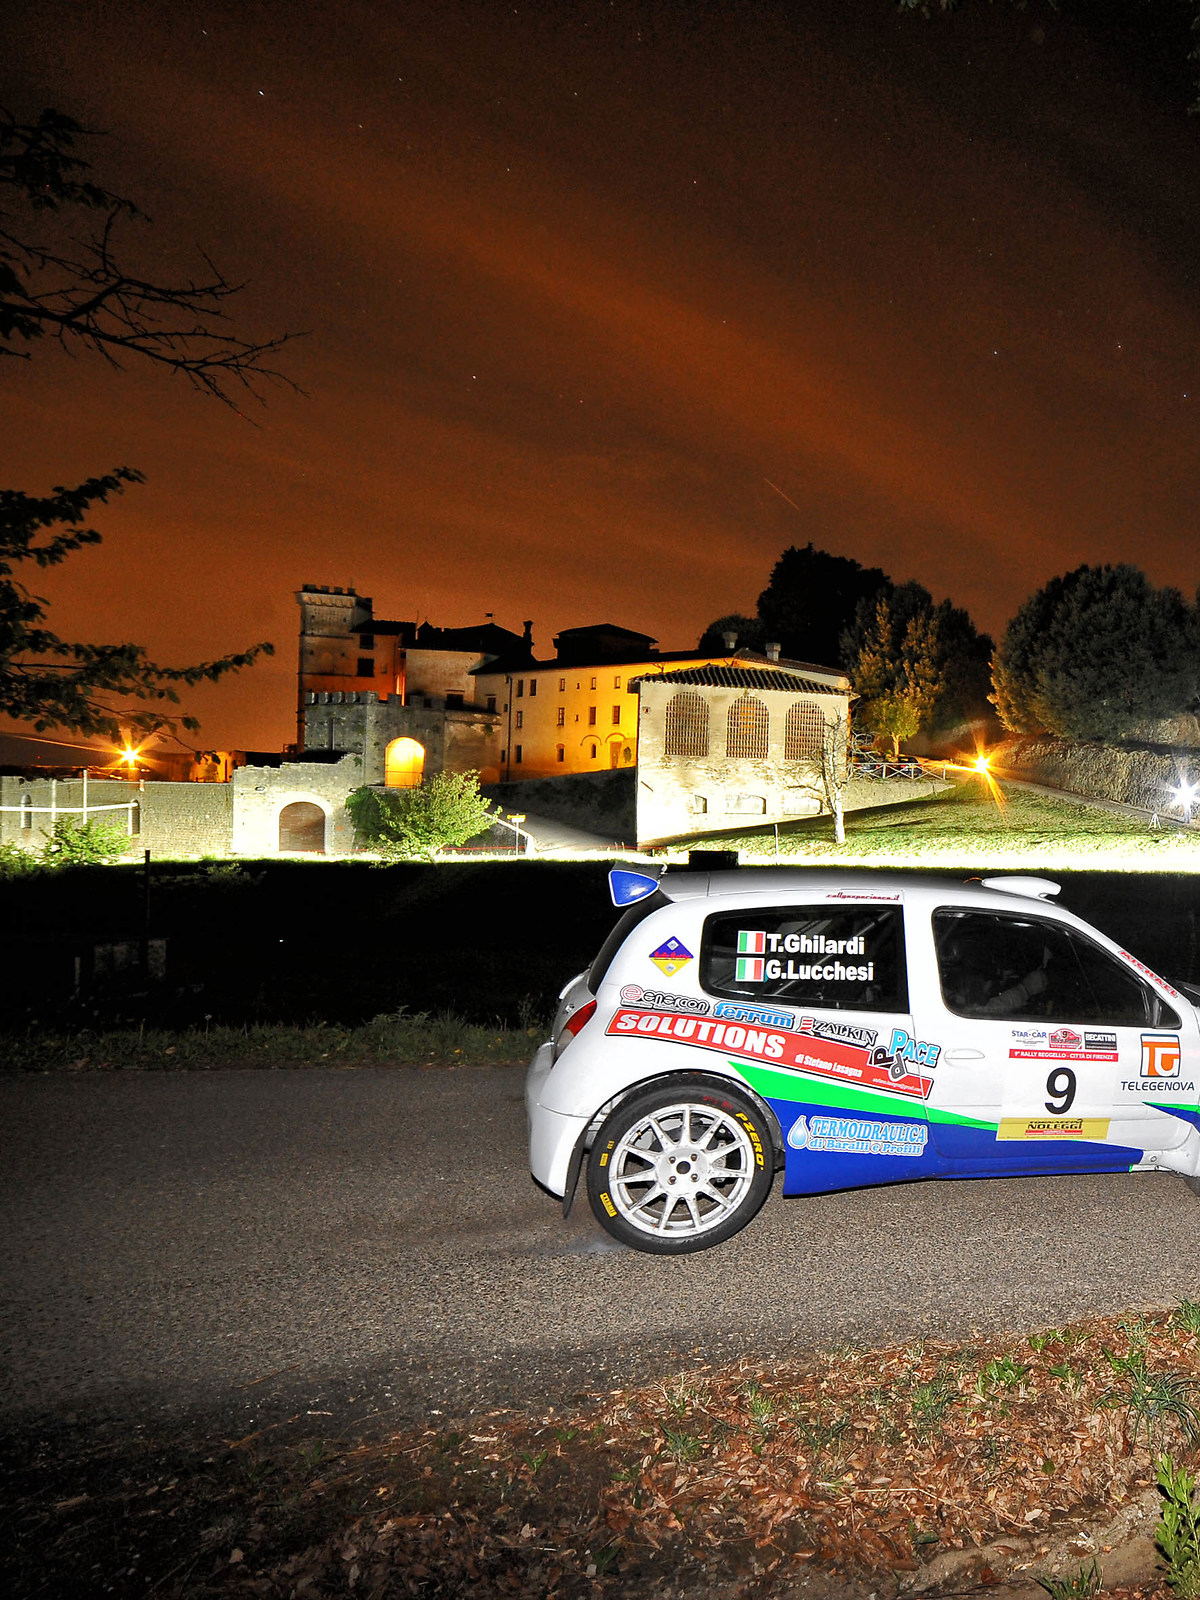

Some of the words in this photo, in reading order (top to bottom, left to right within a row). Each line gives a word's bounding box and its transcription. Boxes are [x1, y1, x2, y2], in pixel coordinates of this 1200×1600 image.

[766, 934, 865, 955] T.Ghilardi
[765, 959, 874, 981] G.Lucchesi
[714, 1003, 794, 1028] ferrum
[615, 1013, 786, 1058] SOLUTIONS
[814, 1022, 878, 1045] ZALKIN
[803, 1056, 833, 1071] Stefano
[1044, 1067, 1077, 1114] 9
[1120, 1081, 1195, 1091] TELEGENOVA
[812, 1119, 926, 1143] TERMOIDRAULICA
[809, 1138, 823, 1149] di
[826, 1139, 869, 1151] Baralli
[883, 1143, 922, 1154] Profili
